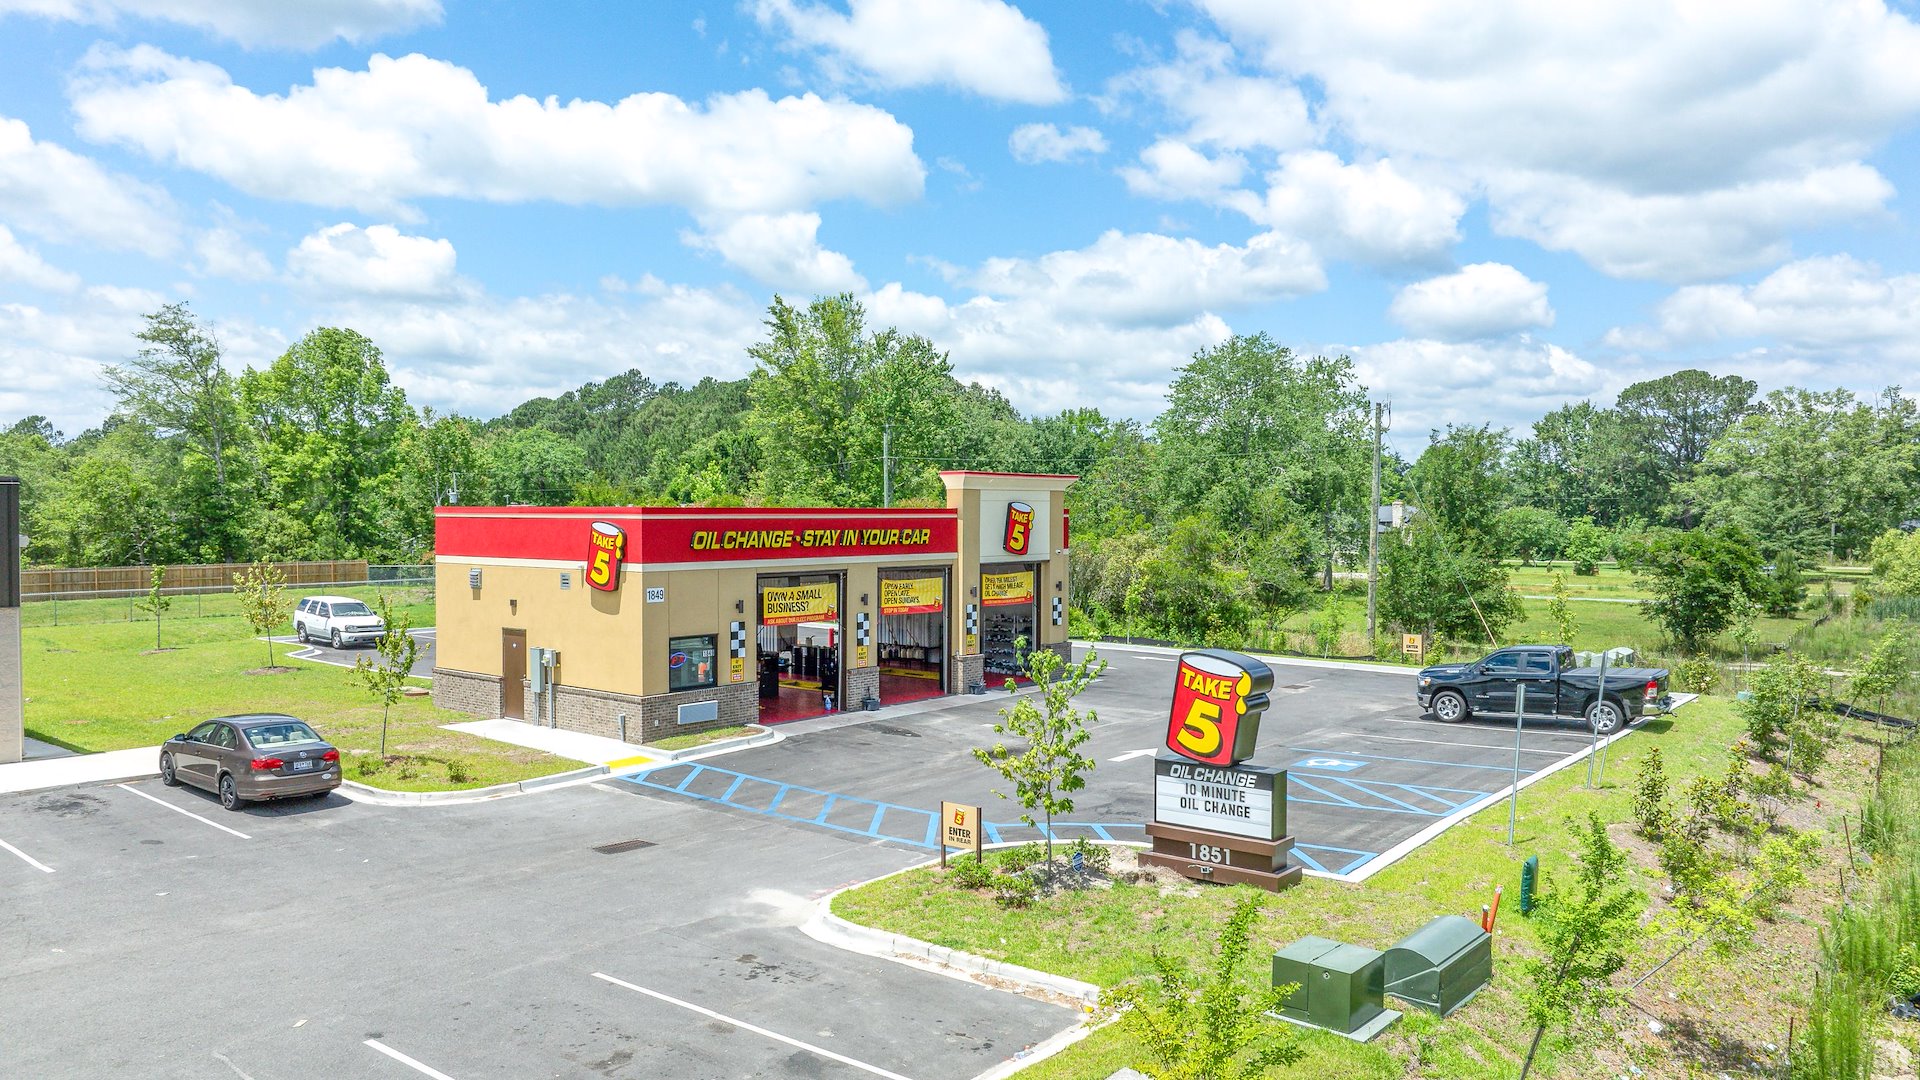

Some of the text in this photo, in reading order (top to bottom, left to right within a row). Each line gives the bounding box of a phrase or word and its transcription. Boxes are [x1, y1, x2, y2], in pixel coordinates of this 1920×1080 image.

[1011, 509, 1029, 523] TAKE
[592, 531, 615, 550] TAKE
[692, 528, 931, 550] OIL CHANGE STAY IN YOUR CAR
[1009, 524, 1025, 551] 5
[590, 550, 610, 585] 5
[647, 589, 664, 600] 1849
[767, 588, 822, 602] OWN A SMALL
[884, 597, 898, 605] OPEN
[767, 601, 810, 614] BUSINESS?
[1181, 667, 1233, 700] TAKE
[1176, 697, 1222, 754] 5
[1170, 764, 1257, 788] OIL CHANGE
[1185, 782, 1246, 803] 10 MINUTE
[1180, 797, 1251, 819] OIL CHANGE
[955, 814, 963, 825] 5
[949, 826, 971, 839] ENTER
[956, 837, 972, 845] REAR
[1189, 842, 1231, 865] 1851
